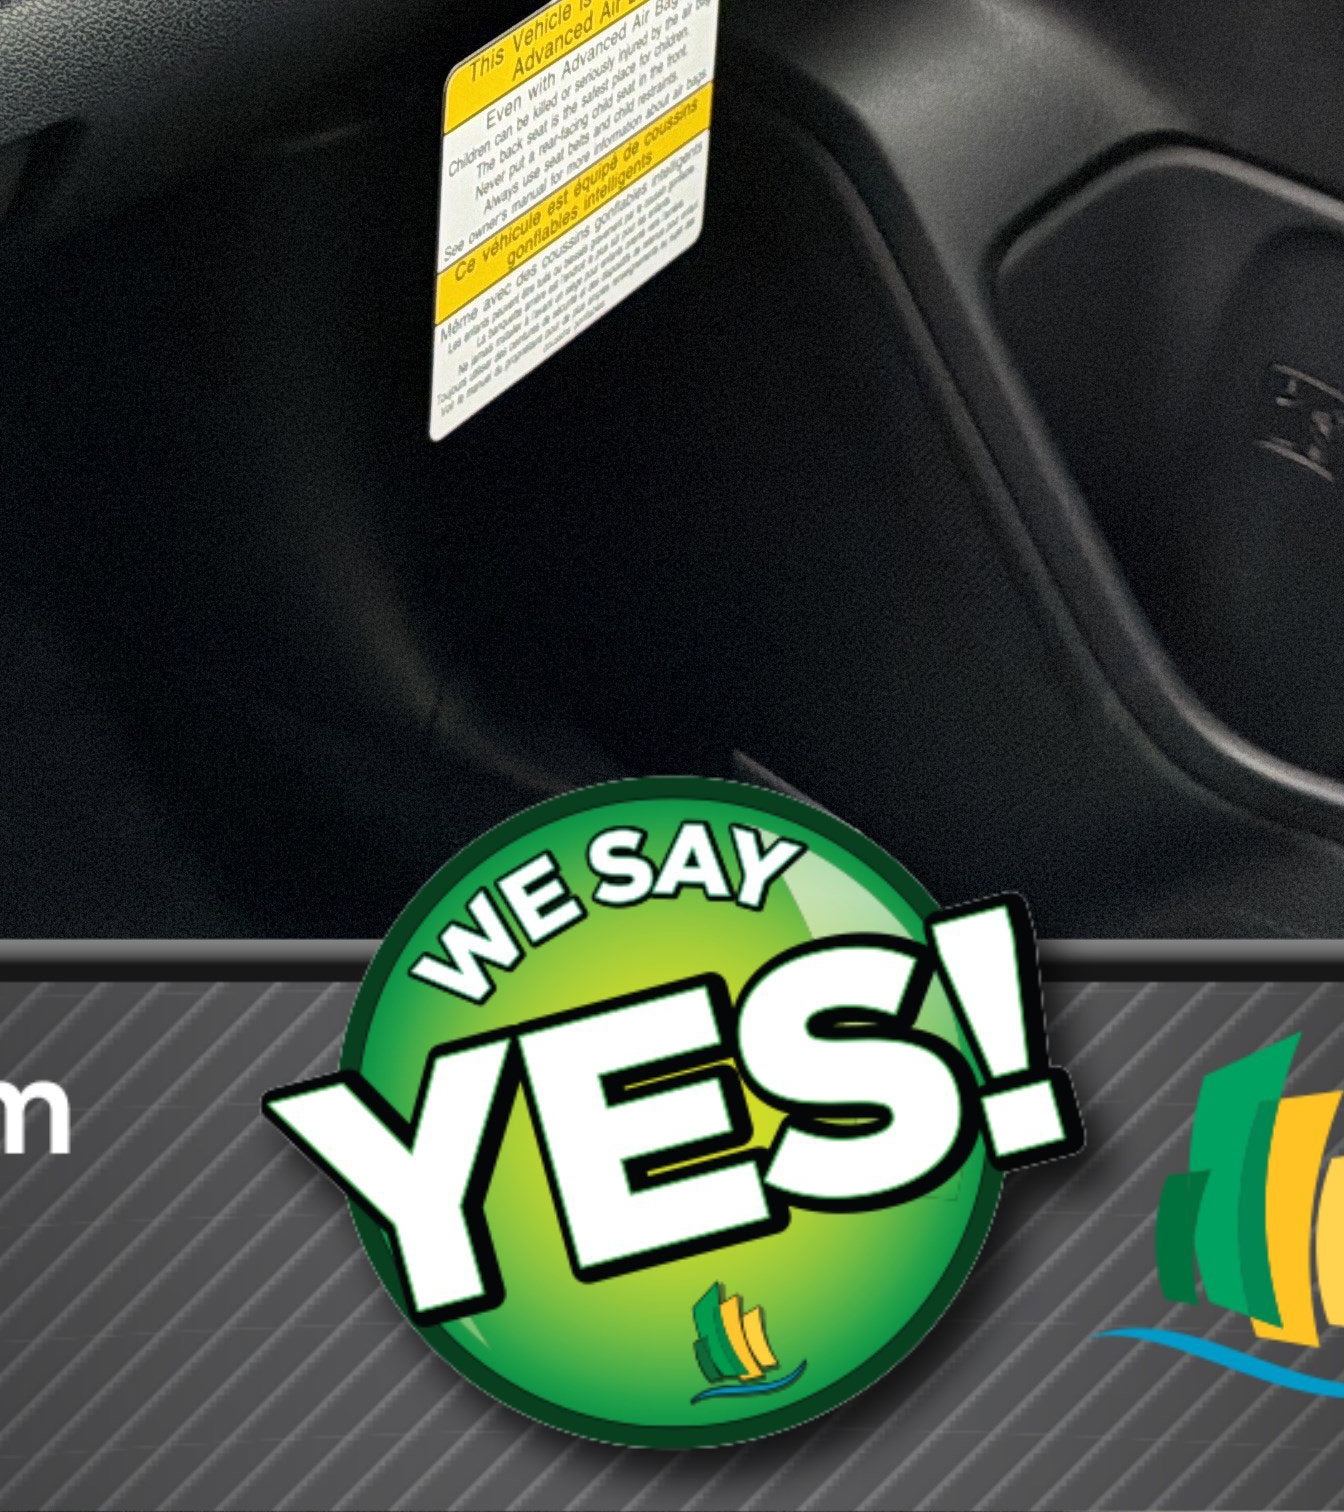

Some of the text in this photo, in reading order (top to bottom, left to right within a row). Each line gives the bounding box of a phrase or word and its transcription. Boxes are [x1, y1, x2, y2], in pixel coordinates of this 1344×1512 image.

[469, 47, 505, 83] This
[512, 3, 572, 53] Vehicle
[486, 95, 522, 131] Even
[527, 72, 556, 101] with
[560, 21, 628, 80] Advanced
[631, 9, 651, 33] Air
[511, 9, 594, 82] Advanced
[454, 257, 477, 282] Ce
[481, 211, 542, 263] véhicule
[546, 188, 569, 217] est
[622, 140, 640, 163] de
[643, 97, 699, 147] coussins
[506, 150, 653, 270] gonflables intelligents
